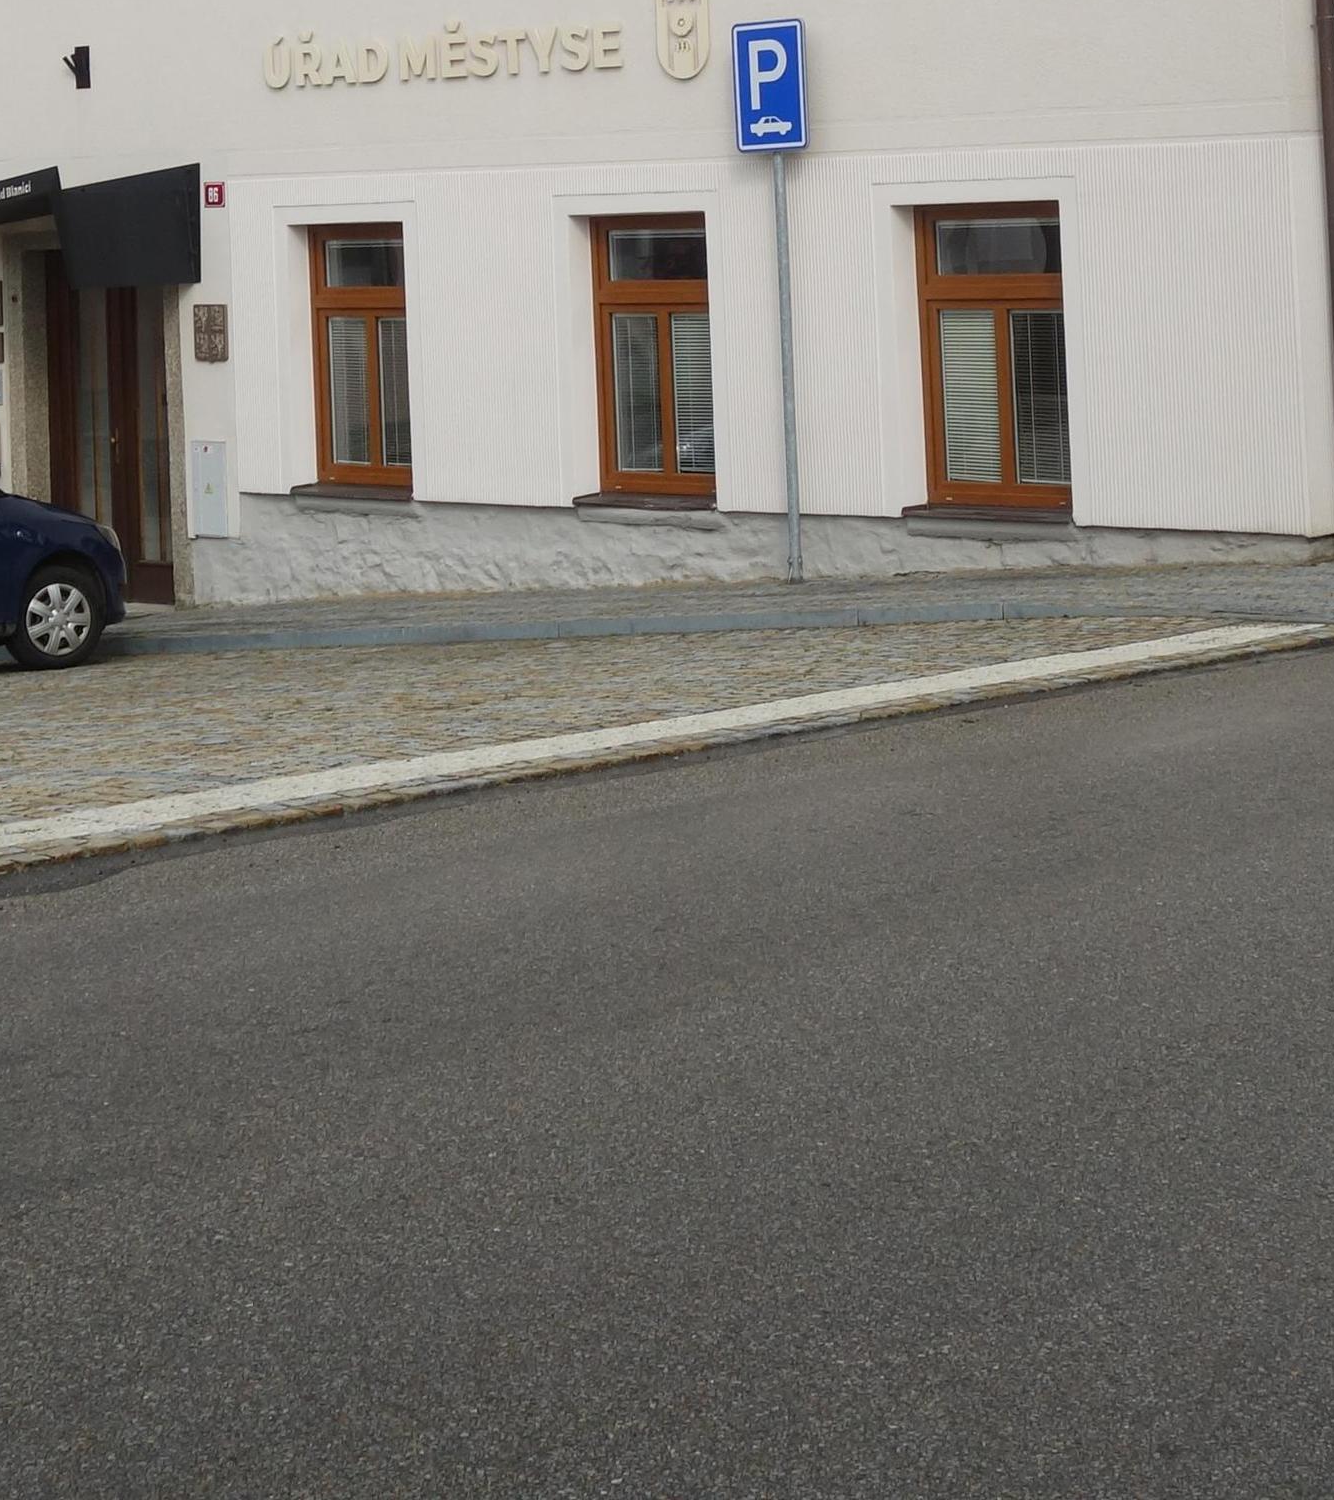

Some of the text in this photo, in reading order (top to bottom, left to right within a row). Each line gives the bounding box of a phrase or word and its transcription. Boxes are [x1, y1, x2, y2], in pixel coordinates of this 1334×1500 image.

[265, 20, 623, 89] ÚŘAD MĚSTYSE
[748, 39, 787, 110] P
